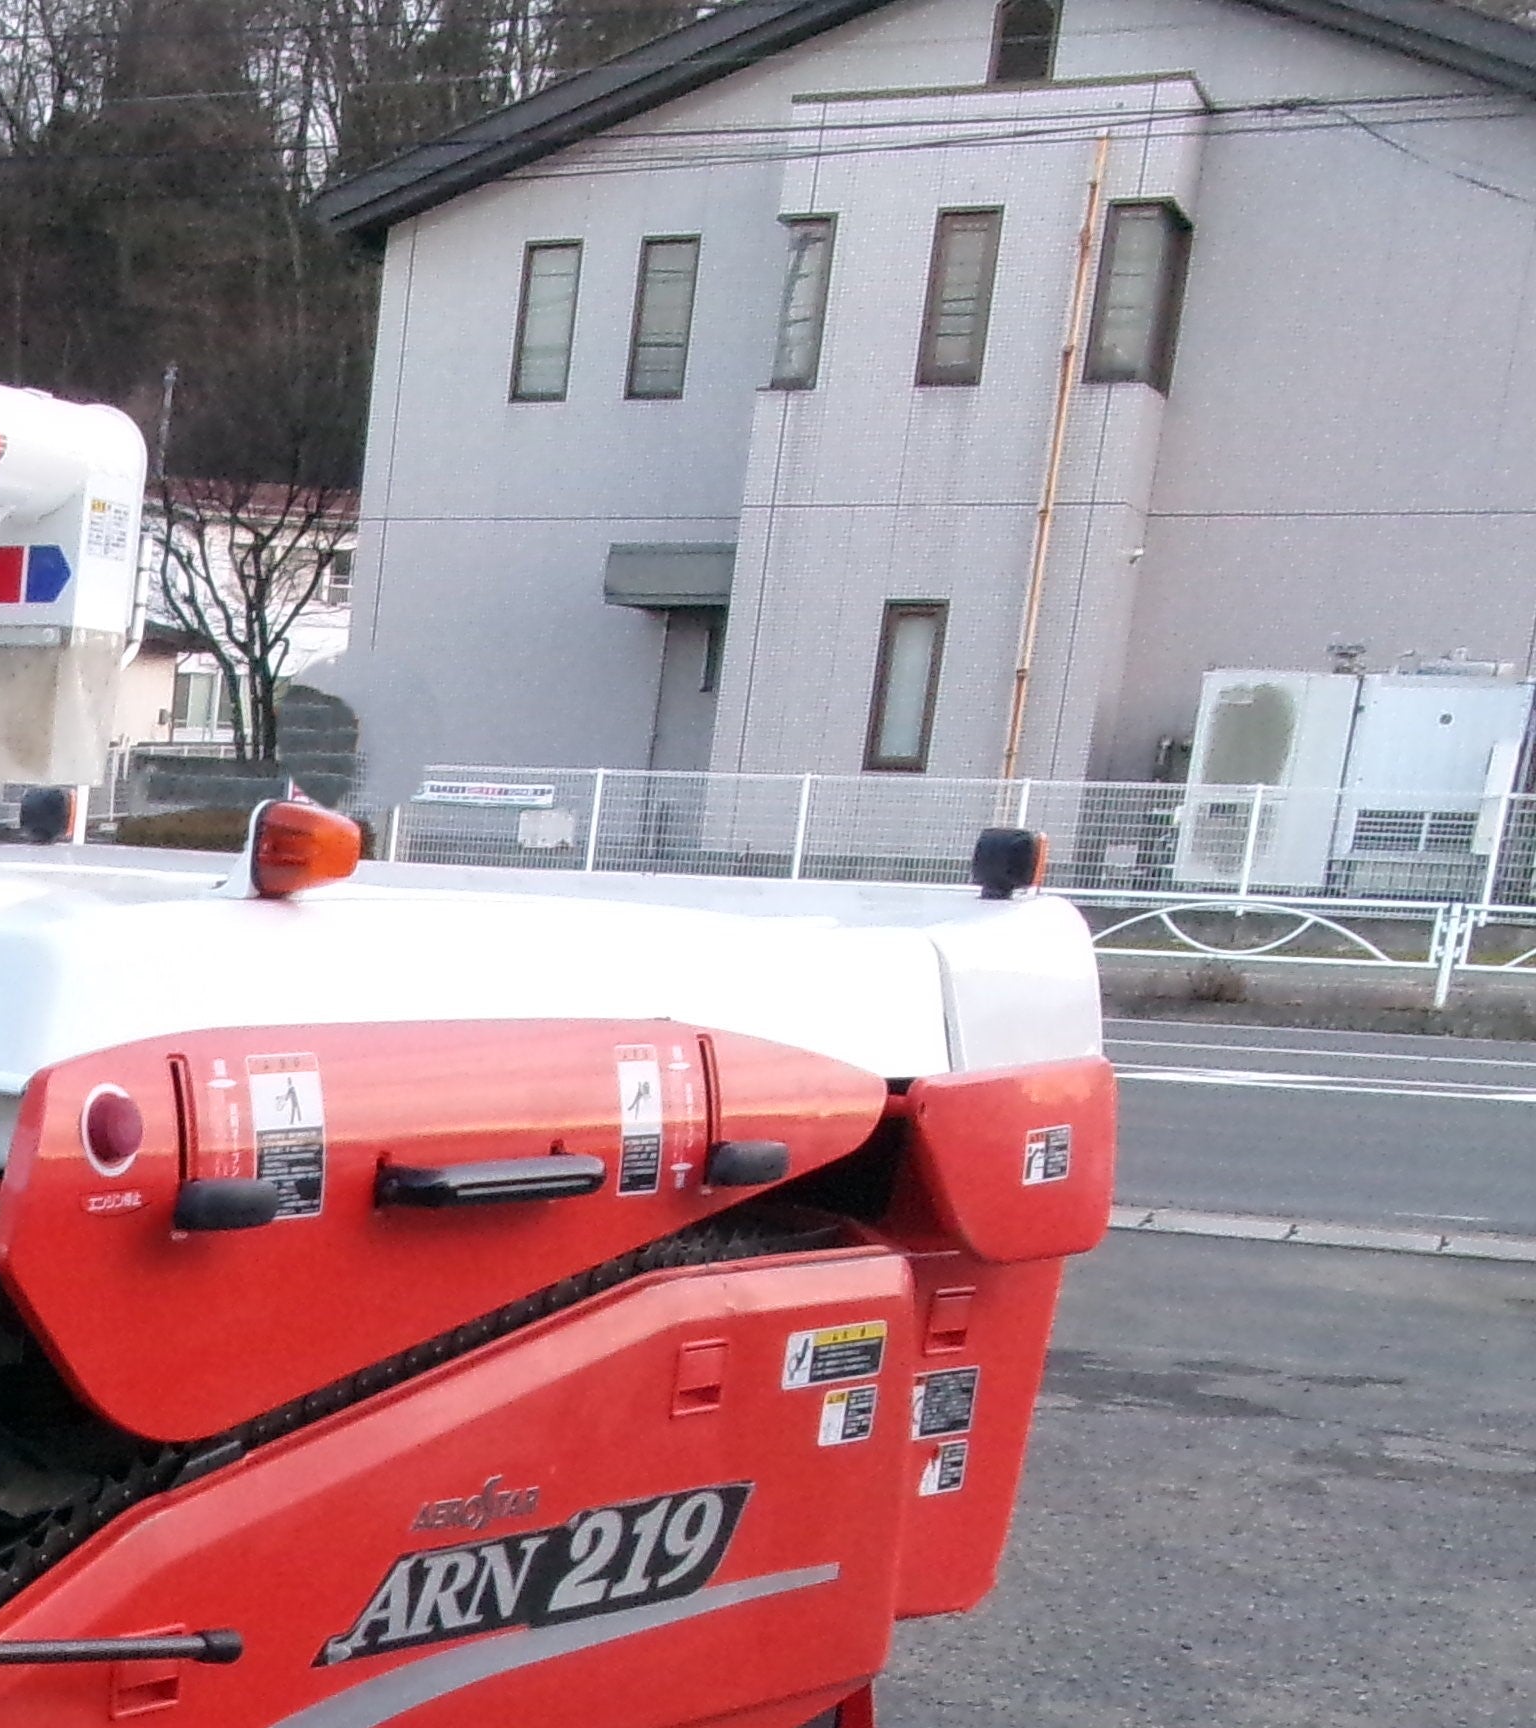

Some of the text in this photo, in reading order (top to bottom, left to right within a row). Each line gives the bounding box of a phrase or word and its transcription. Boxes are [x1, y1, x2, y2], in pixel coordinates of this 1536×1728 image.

[410, 1474, 542, 1531] AEROSTAR
[328, 1491, 726, 1650] ARN 219
